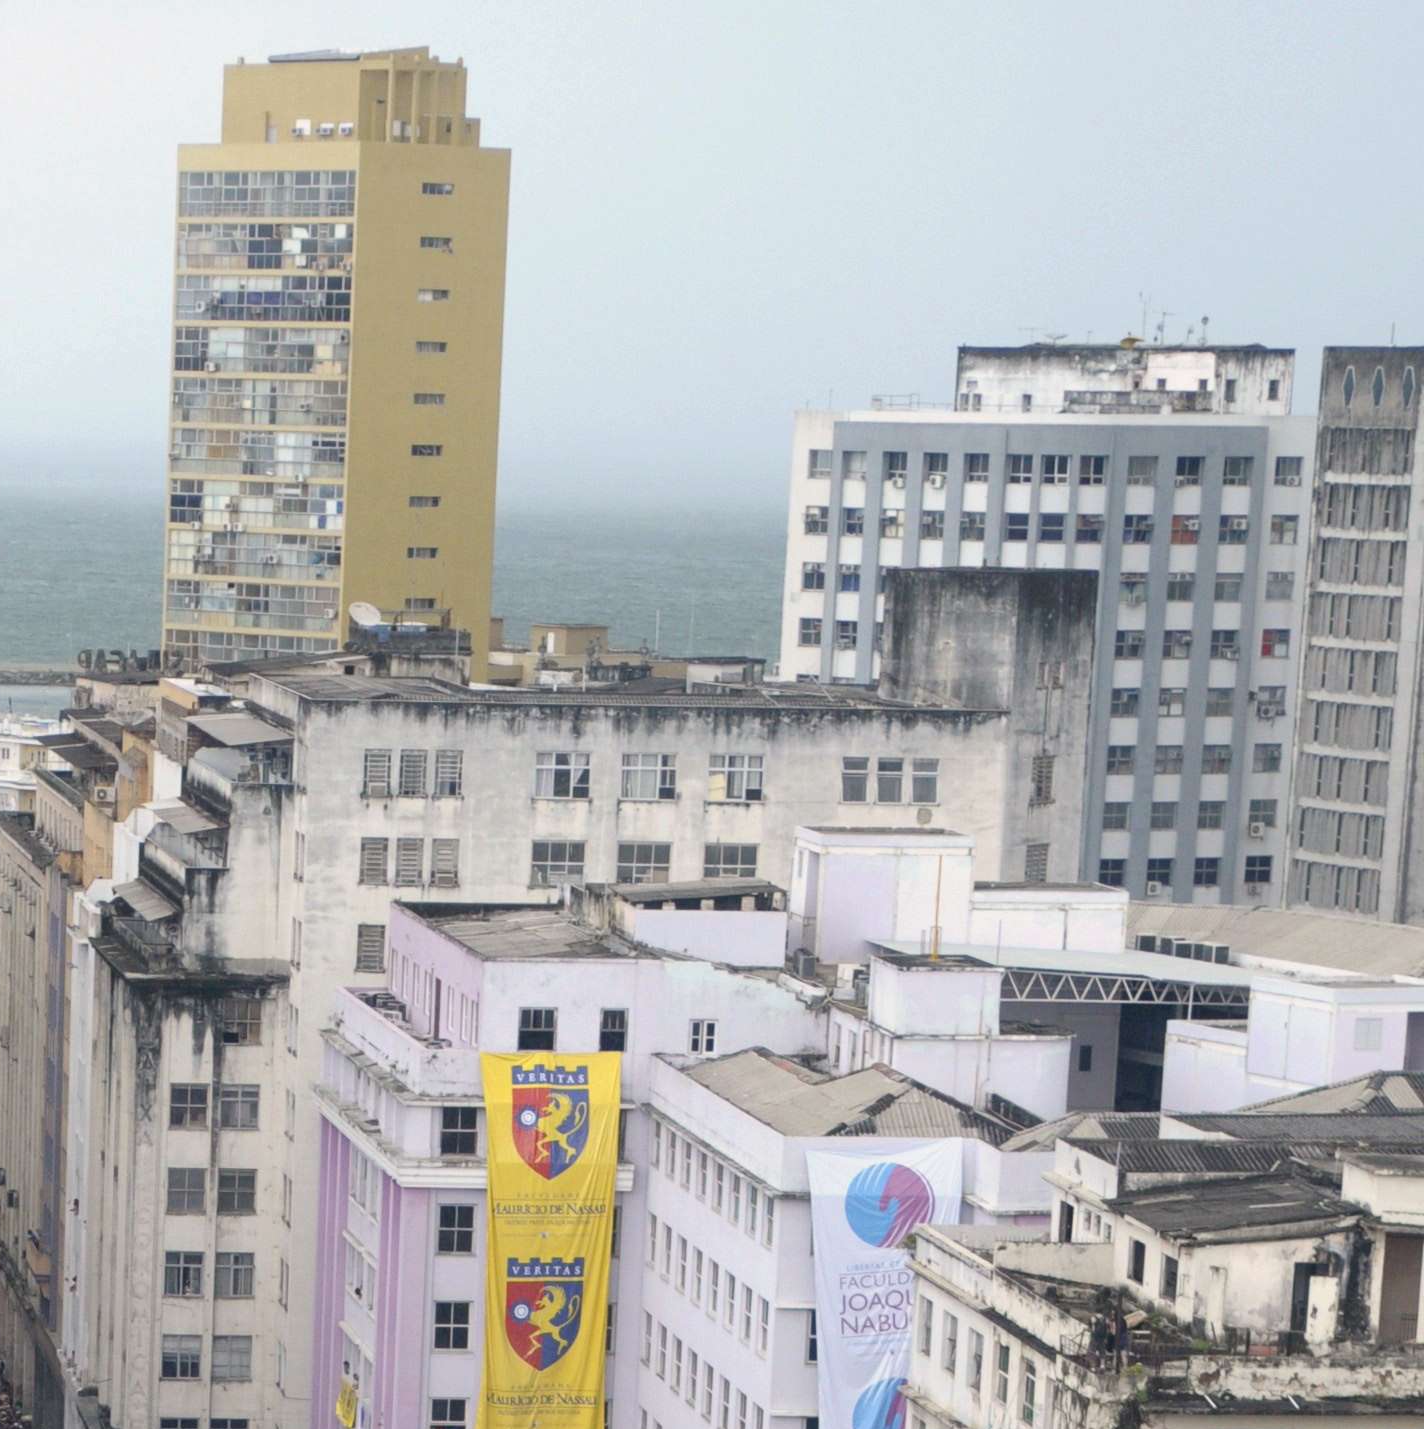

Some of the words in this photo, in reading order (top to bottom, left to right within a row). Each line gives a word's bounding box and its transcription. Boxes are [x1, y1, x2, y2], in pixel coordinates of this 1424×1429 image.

[516, 1072, 585, 1084] VERITAS
[549, 1204, 563, 1215] DE
[512, 1265, 582, 1276] VERITAS
[839, 1271, 910, 1290] FACULD
[840, 1311, 912, 1335] NABU
[540, 1395, 555, 1405] DE
